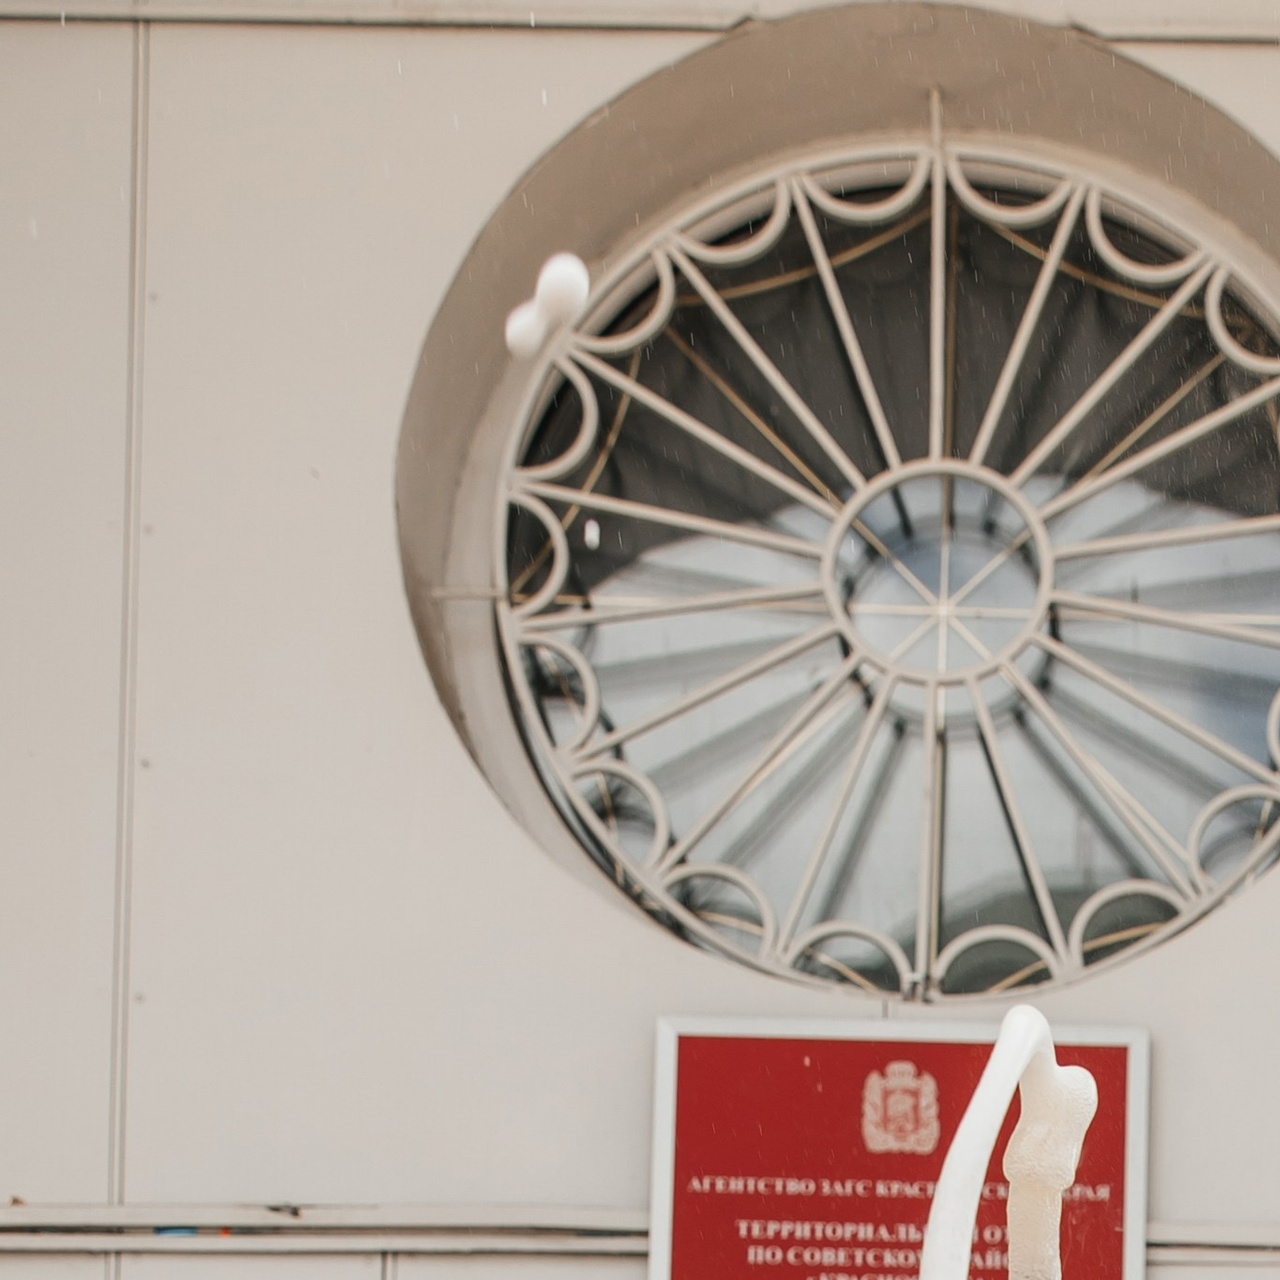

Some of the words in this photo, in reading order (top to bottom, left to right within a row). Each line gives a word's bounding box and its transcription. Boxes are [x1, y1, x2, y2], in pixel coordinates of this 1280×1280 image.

[687, 1175, 817, 1197] АГЕНТСТВО
[819, 1178, 873, 1198] ЗАГС
[735, 1219, 978, 1244] ТЕРРИТОРИАЛЬ
[747, 1245, 784, 1267] ПО
[786, 1246, 923, 1270] СОВЕТСКО
